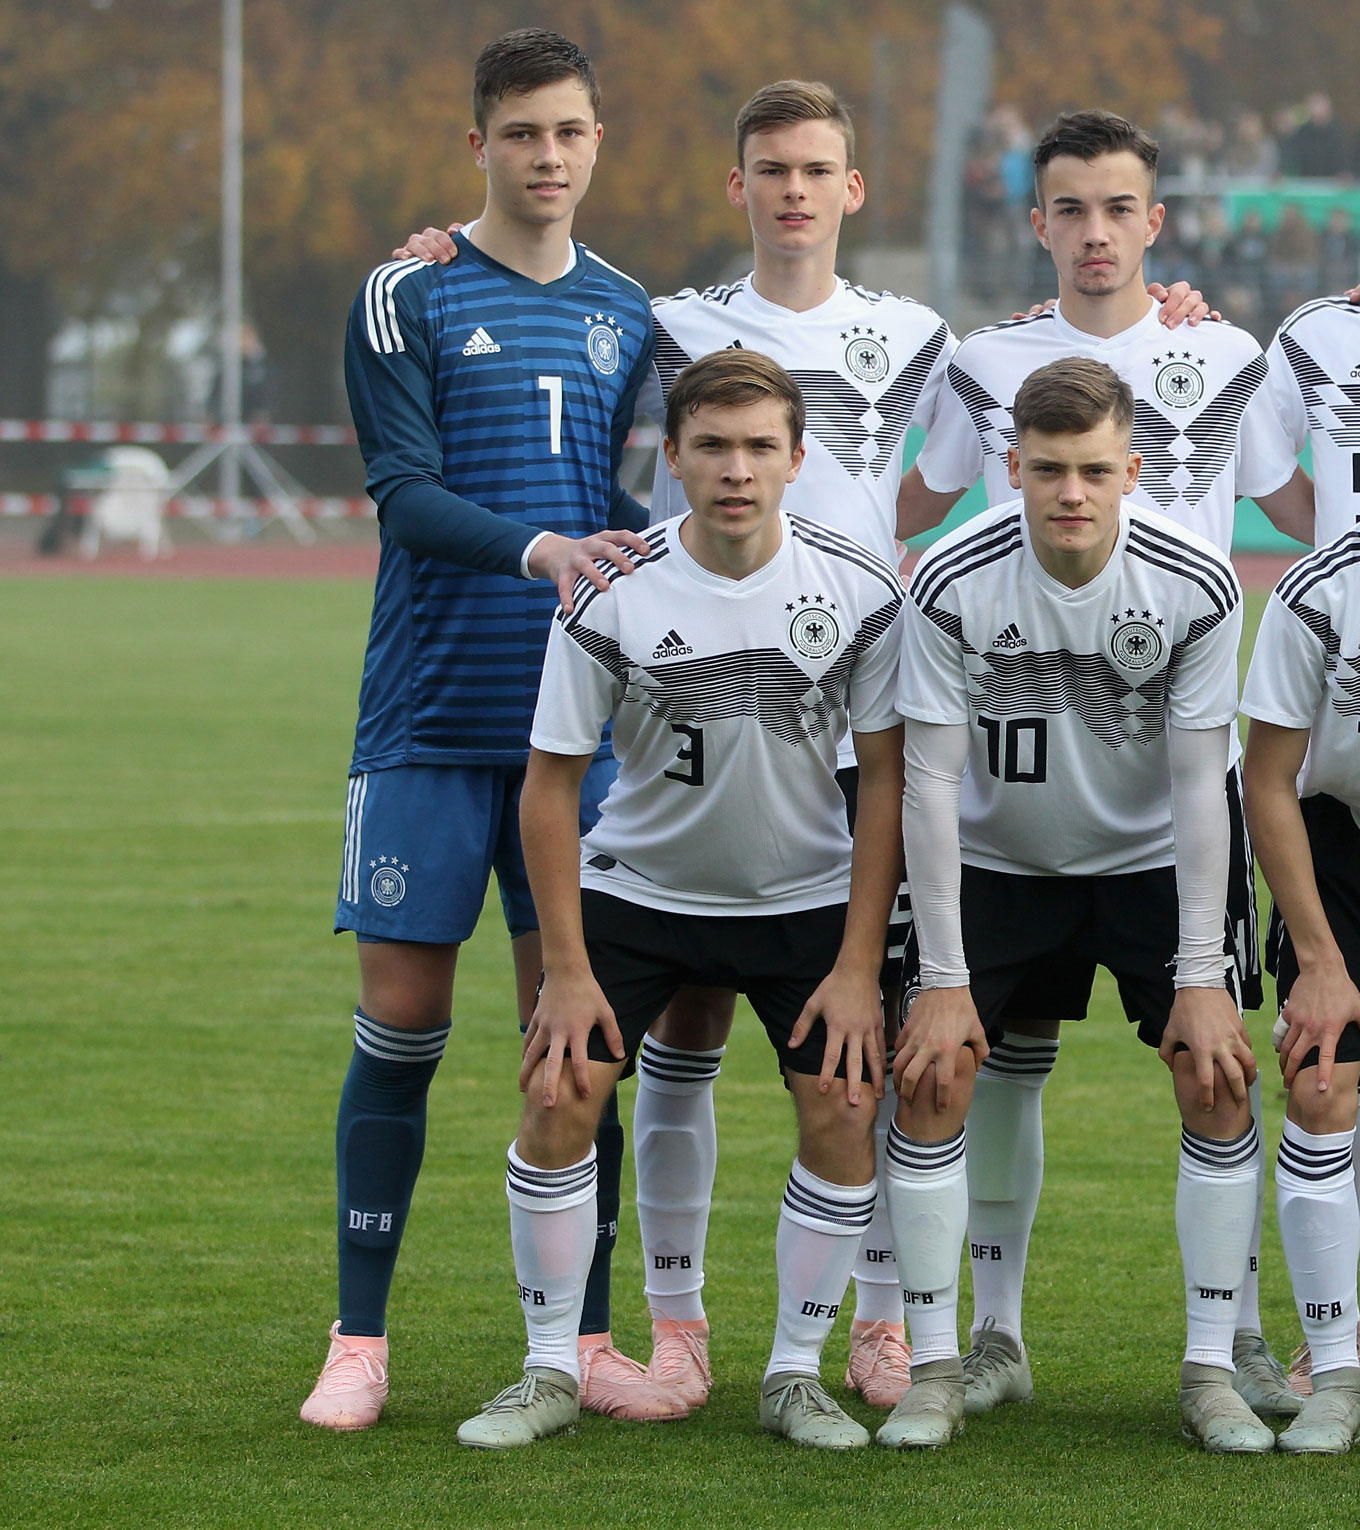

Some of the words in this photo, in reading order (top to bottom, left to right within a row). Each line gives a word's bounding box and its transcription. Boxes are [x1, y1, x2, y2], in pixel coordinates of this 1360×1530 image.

[462, 343, 501, 356] adidas
[538, 376, 562, 454] 1
[992, 638, 1028, 649] adidas
[652, 645, 694, 660] adidas
[664, 723, 704, 787] 3
[977, 714, 1047, 783] 10
[349, 1209, 393, 1232] DFB
[597, 1221, 617, 1238] FB
[866, 1248, 896, 1263] DF
[971, 1243, 1002, 1260] DFB
[654, 1255, 692, 1269] DFB
[903, 1288, 934, 1304] DFB
[1199, 1287, 1233, 1300] DFB
[801, 1300, 839, 1319] DFB
[1305, 1300, 1343, 1321] DFB
